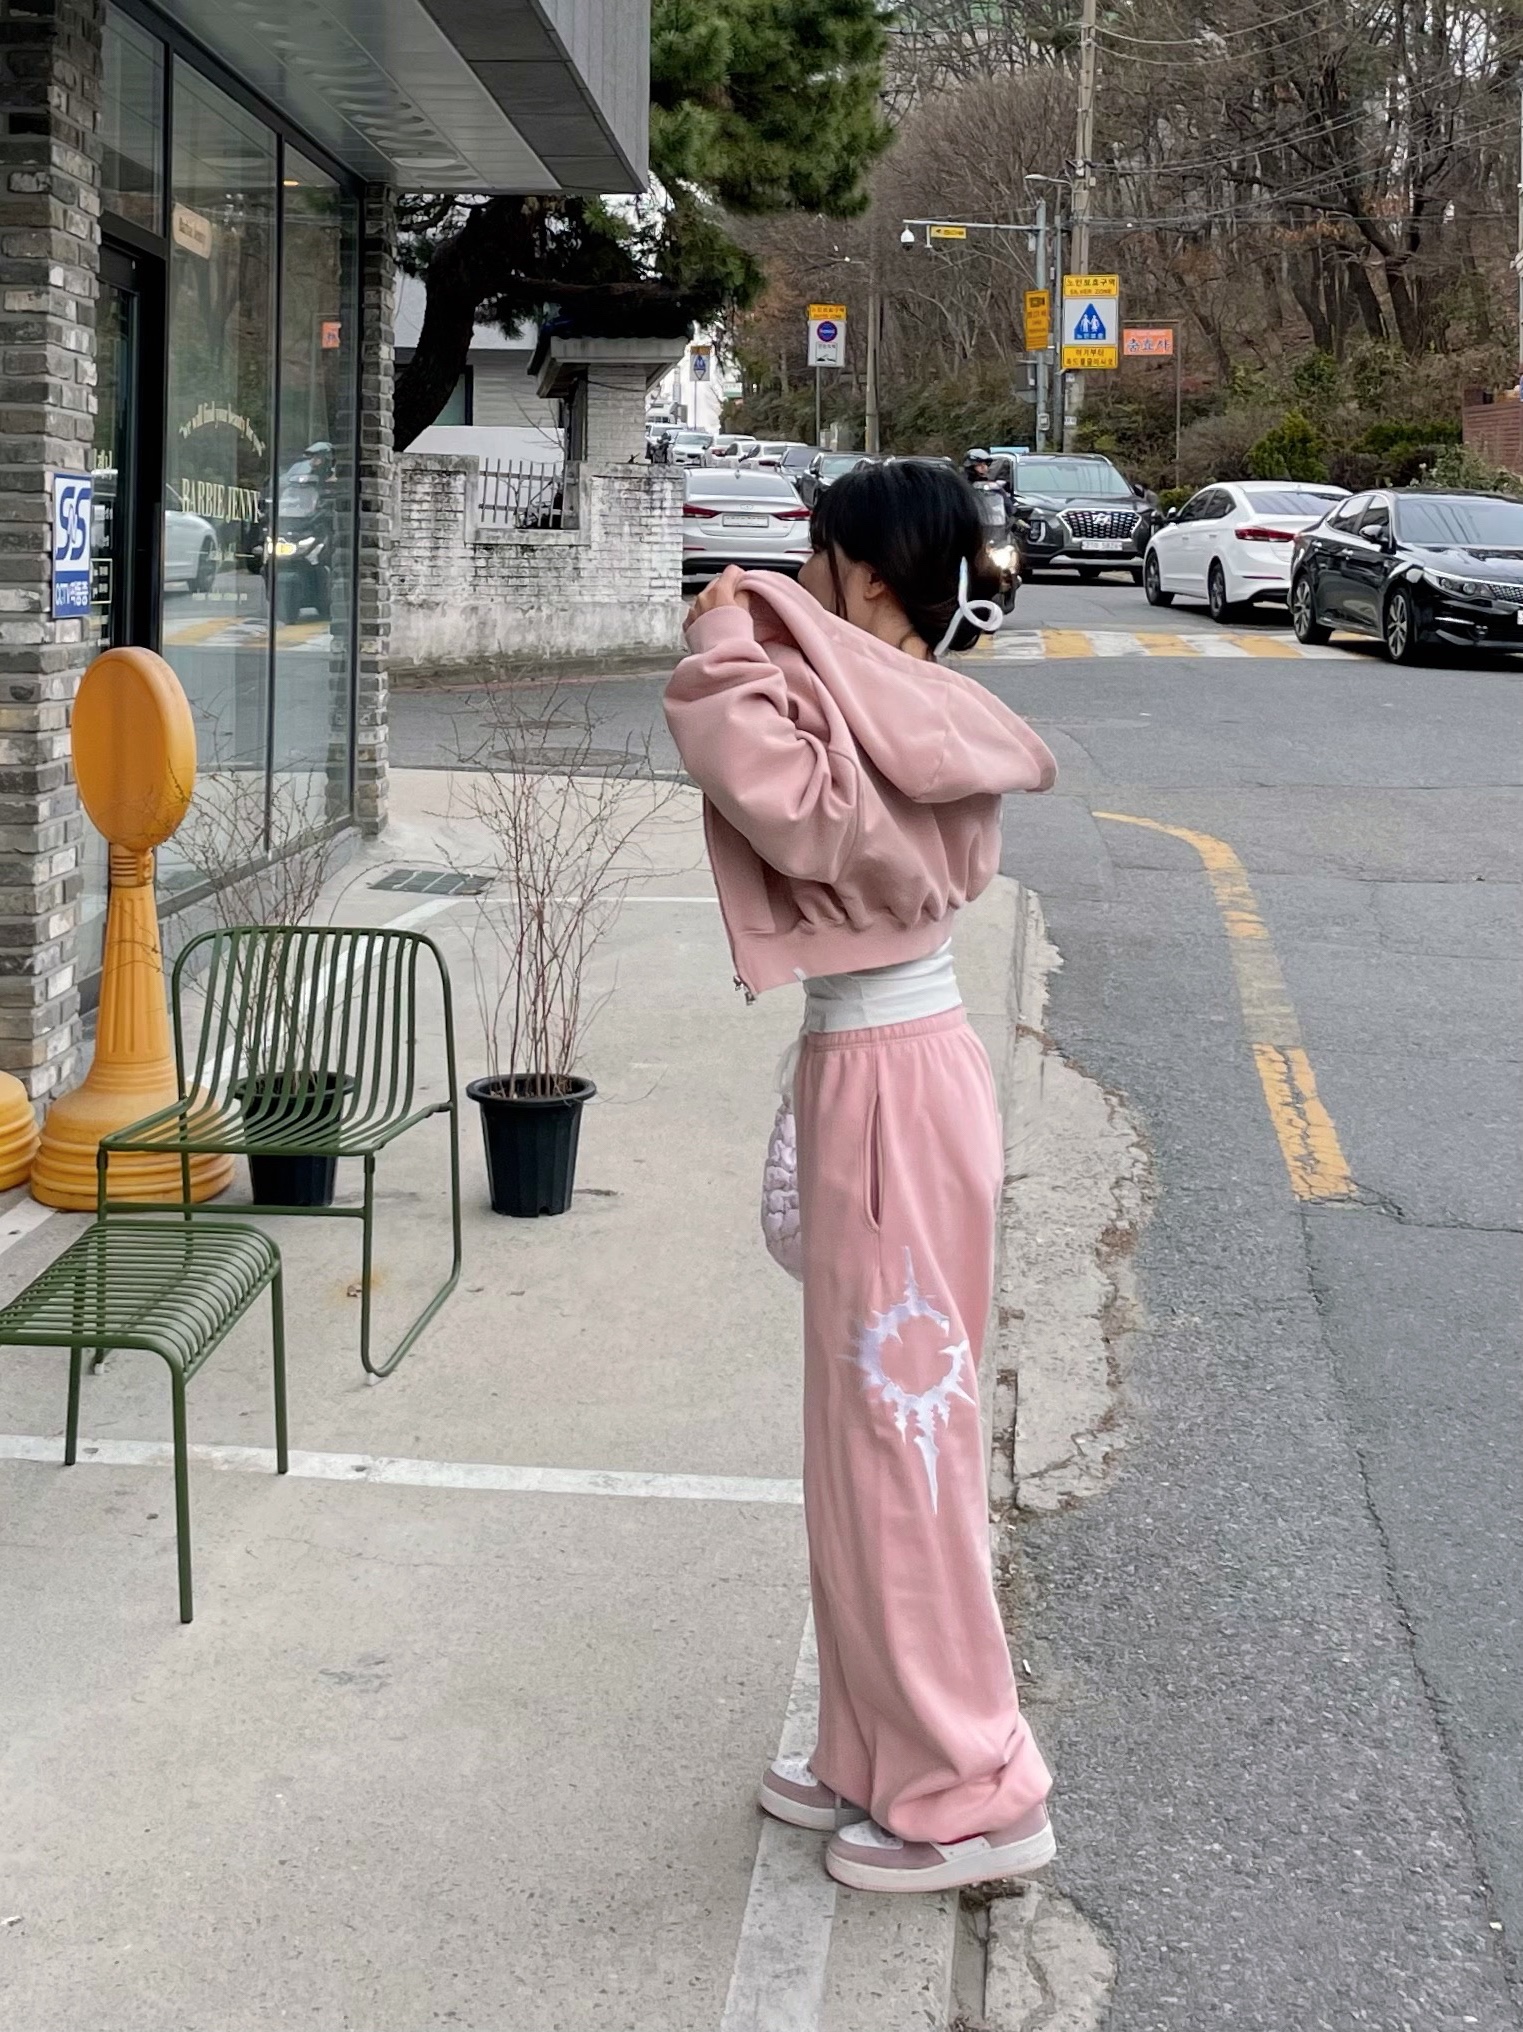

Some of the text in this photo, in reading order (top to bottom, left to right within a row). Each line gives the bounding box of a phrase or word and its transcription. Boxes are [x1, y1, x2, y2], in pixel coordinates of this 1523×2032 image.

[1066, 278, 1115, 287] 노인보호구역
[1075, 348, 1105, 357] 여기부터
[181, 478, 262, 525] BARBIE JENNY
